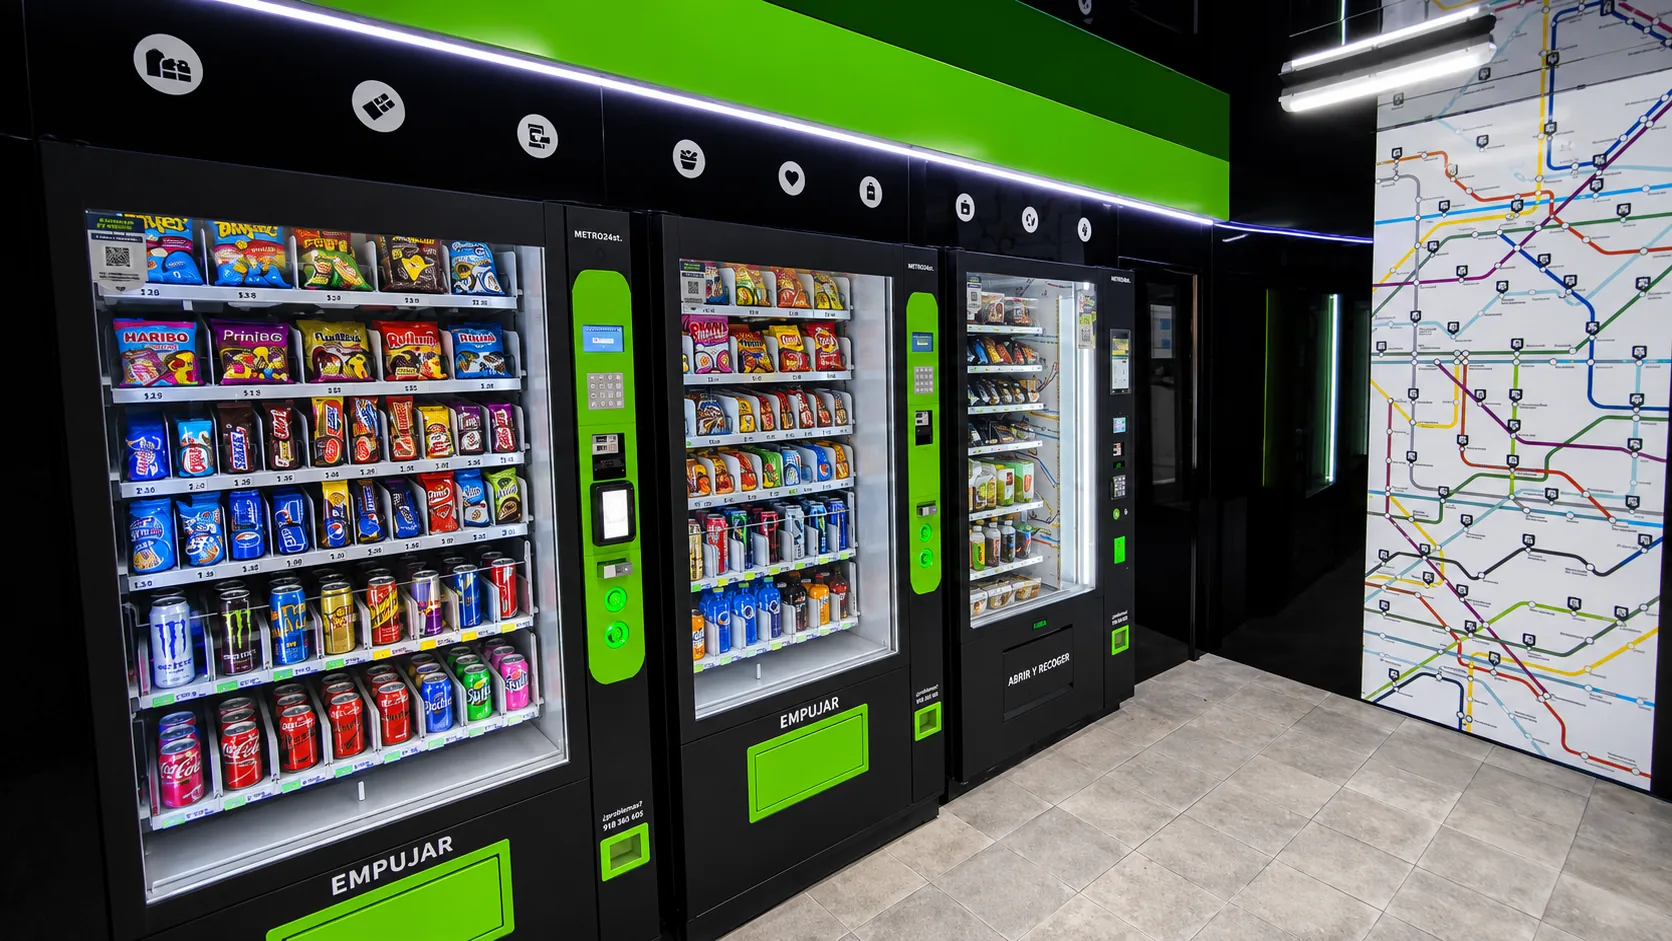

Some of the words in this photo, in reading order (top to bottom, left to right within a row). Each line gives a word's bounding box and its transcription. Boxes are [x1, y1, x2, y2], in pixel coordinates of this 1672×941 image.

[574, 230, 623, 242] METRO24st.
[123, 331, 190, 344] HARIBO
[1007, 669, 1031, 686] ABRIR
[1031, 666, 1038, 676] Y
[1038, 652, 1070, 673] RECOGER
[780, 696, 839, 729] EMPUJAR
[331, 835, 453, 896] EMPUJAR
